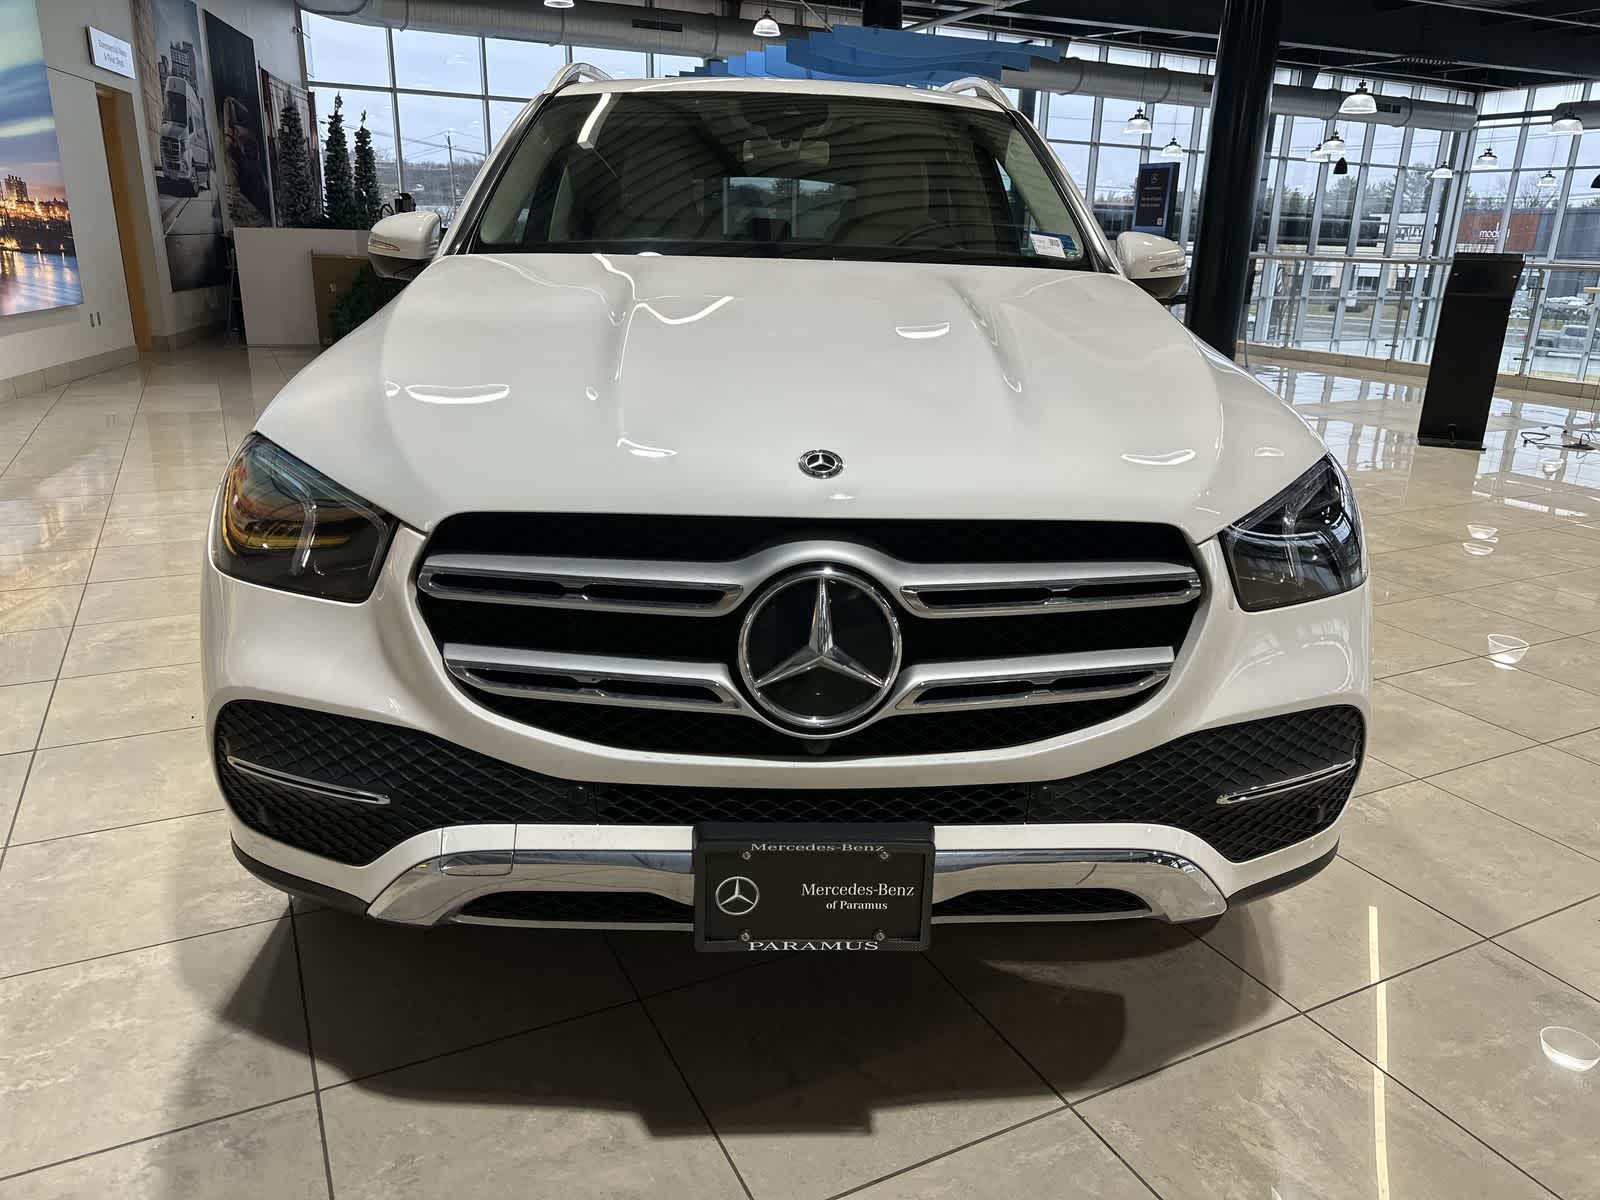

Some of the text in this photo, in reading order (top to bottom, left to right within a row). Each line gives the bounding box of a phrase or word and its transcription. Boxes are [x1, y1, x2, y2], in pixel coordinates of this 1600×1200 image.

[751, 843, 886, 852] Mercedes-Benz
[801, 883, 915, 896] Mercedes-Benz
[826, 900, 888, 910] of Paramus
[748, 941, 879, 951] PARAMUS
